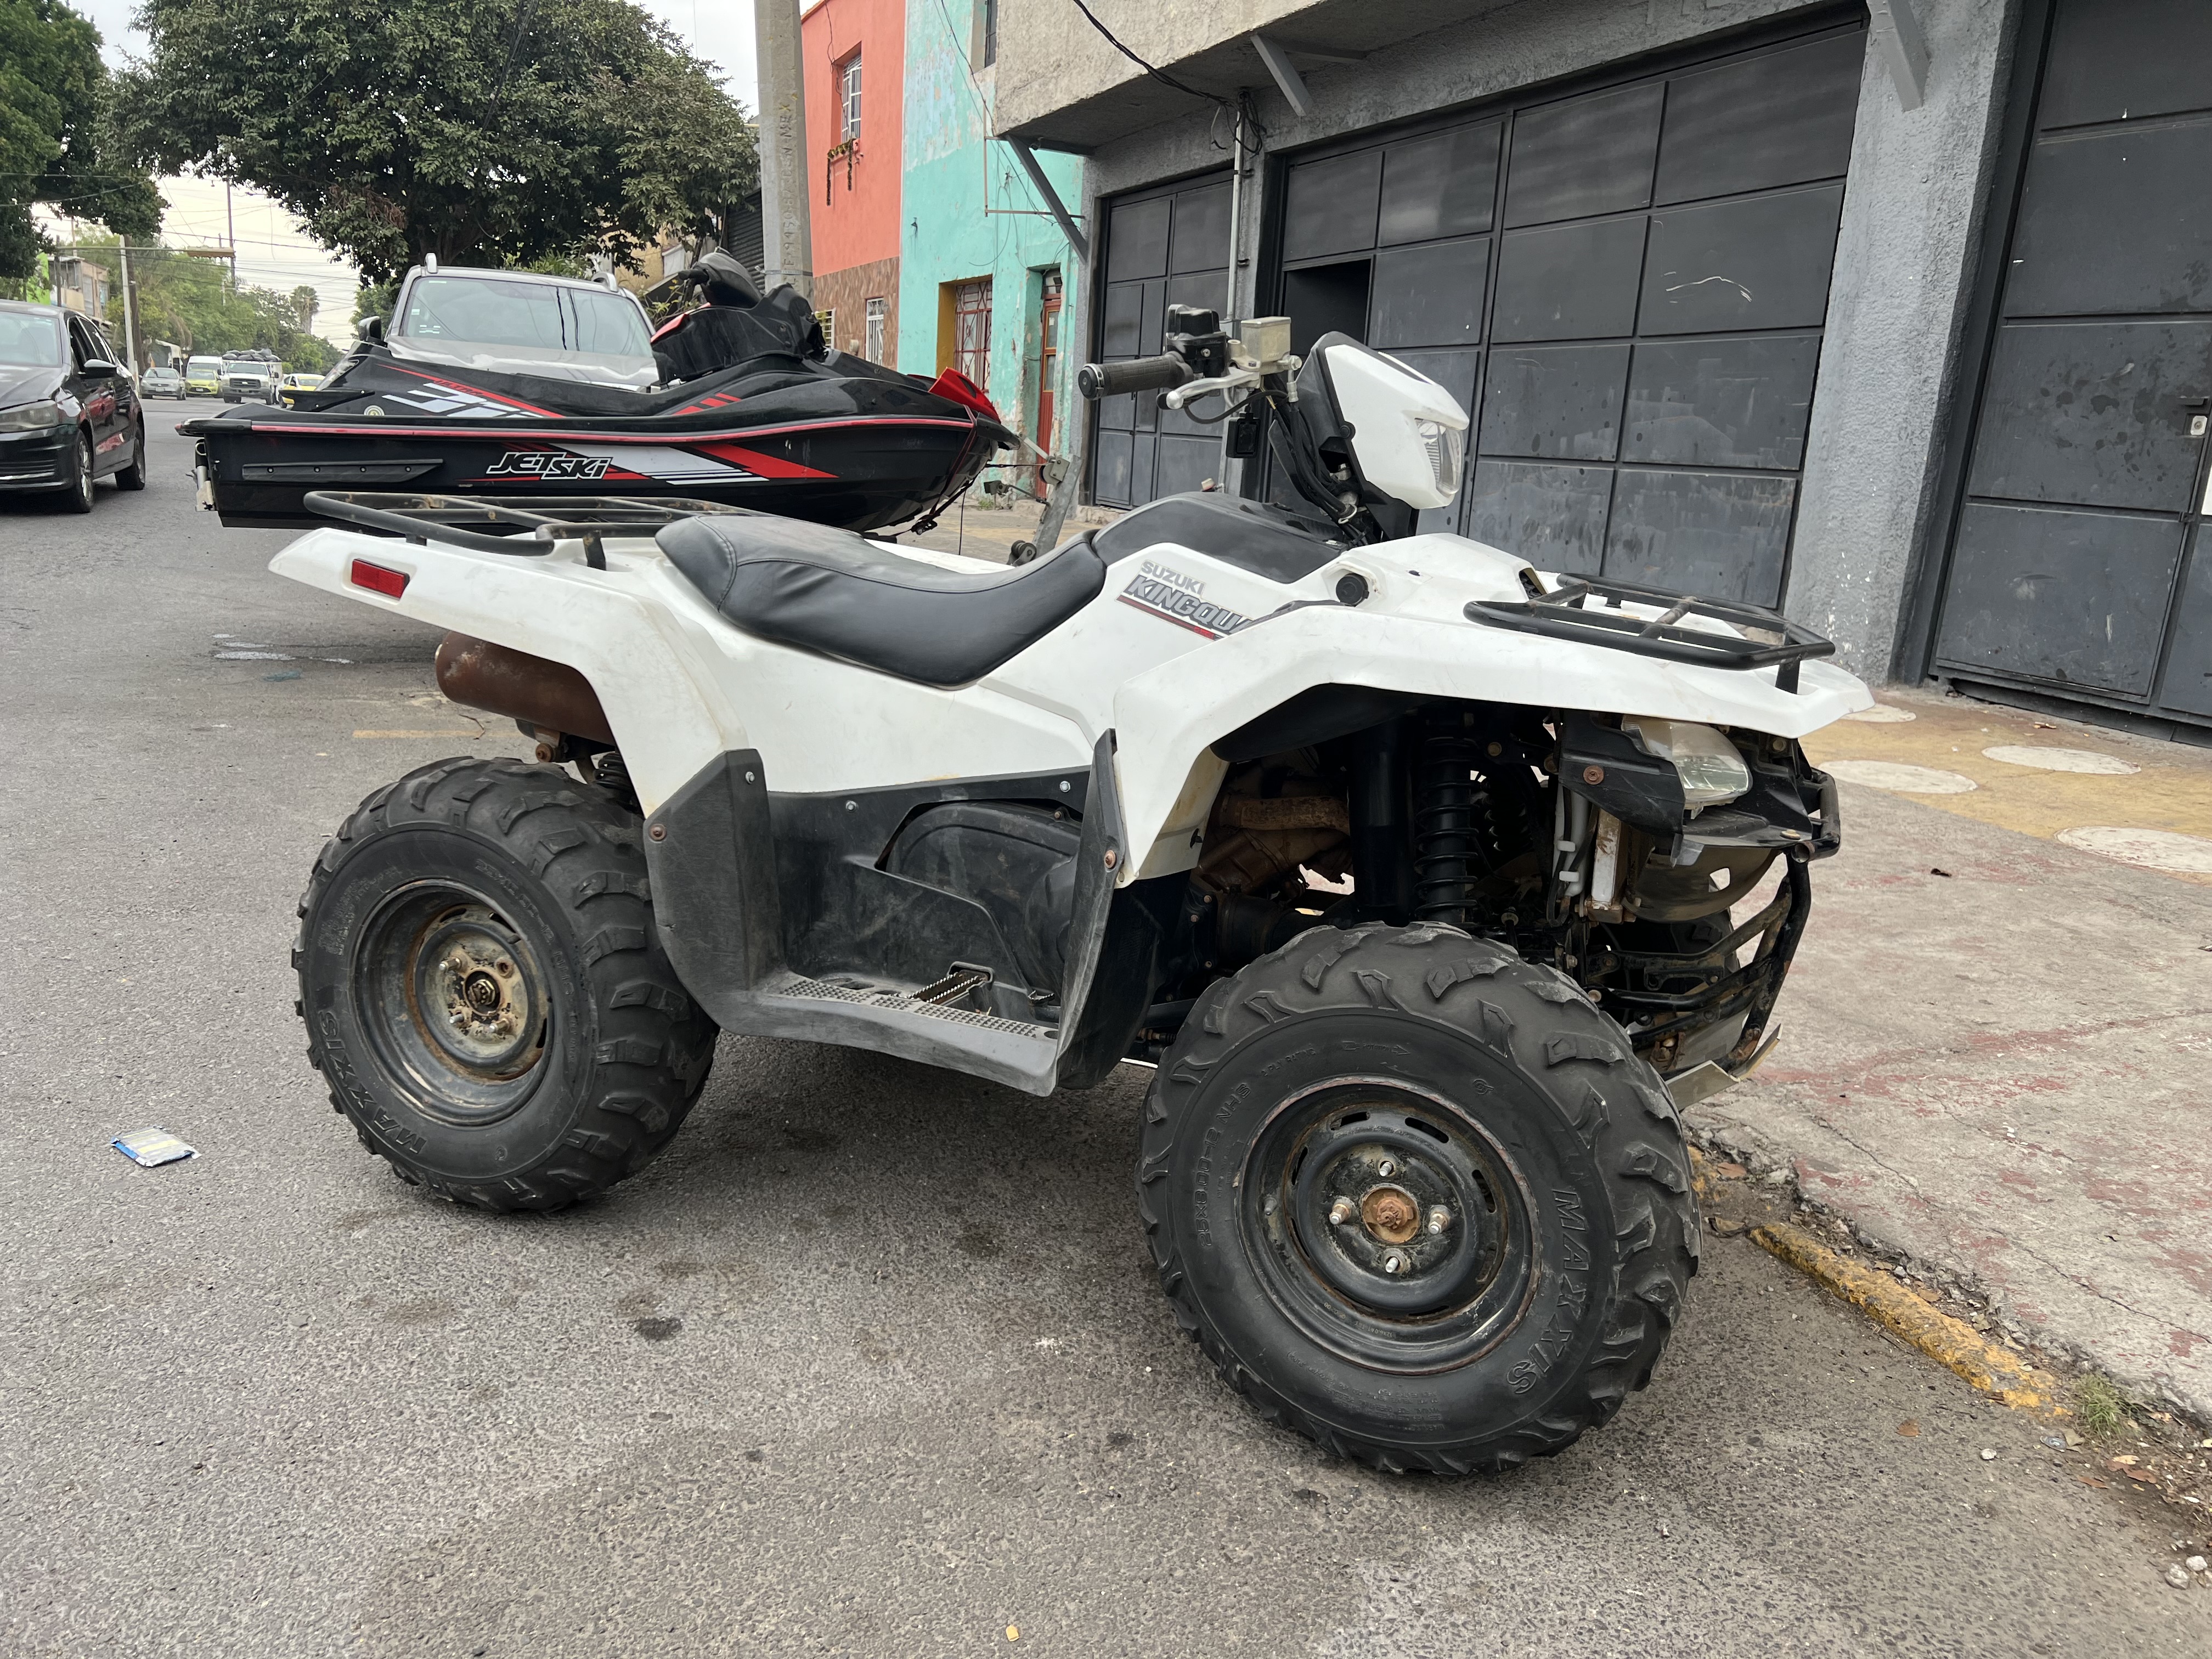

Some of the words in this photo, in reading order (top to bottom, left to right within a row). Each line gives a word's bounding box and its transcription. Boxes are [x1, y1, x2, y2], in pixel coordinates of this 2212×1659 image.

[1141, 561, 1205, 595] SUZUKI
[318, 1009, 427, 1154] MAXXIS
[1193, 1127, 1221, 1248] 25X8.00-12
[1215, 1082, 1252, 1124] NHS
[1506, 1188, 1590, 1395] MAXXIS
